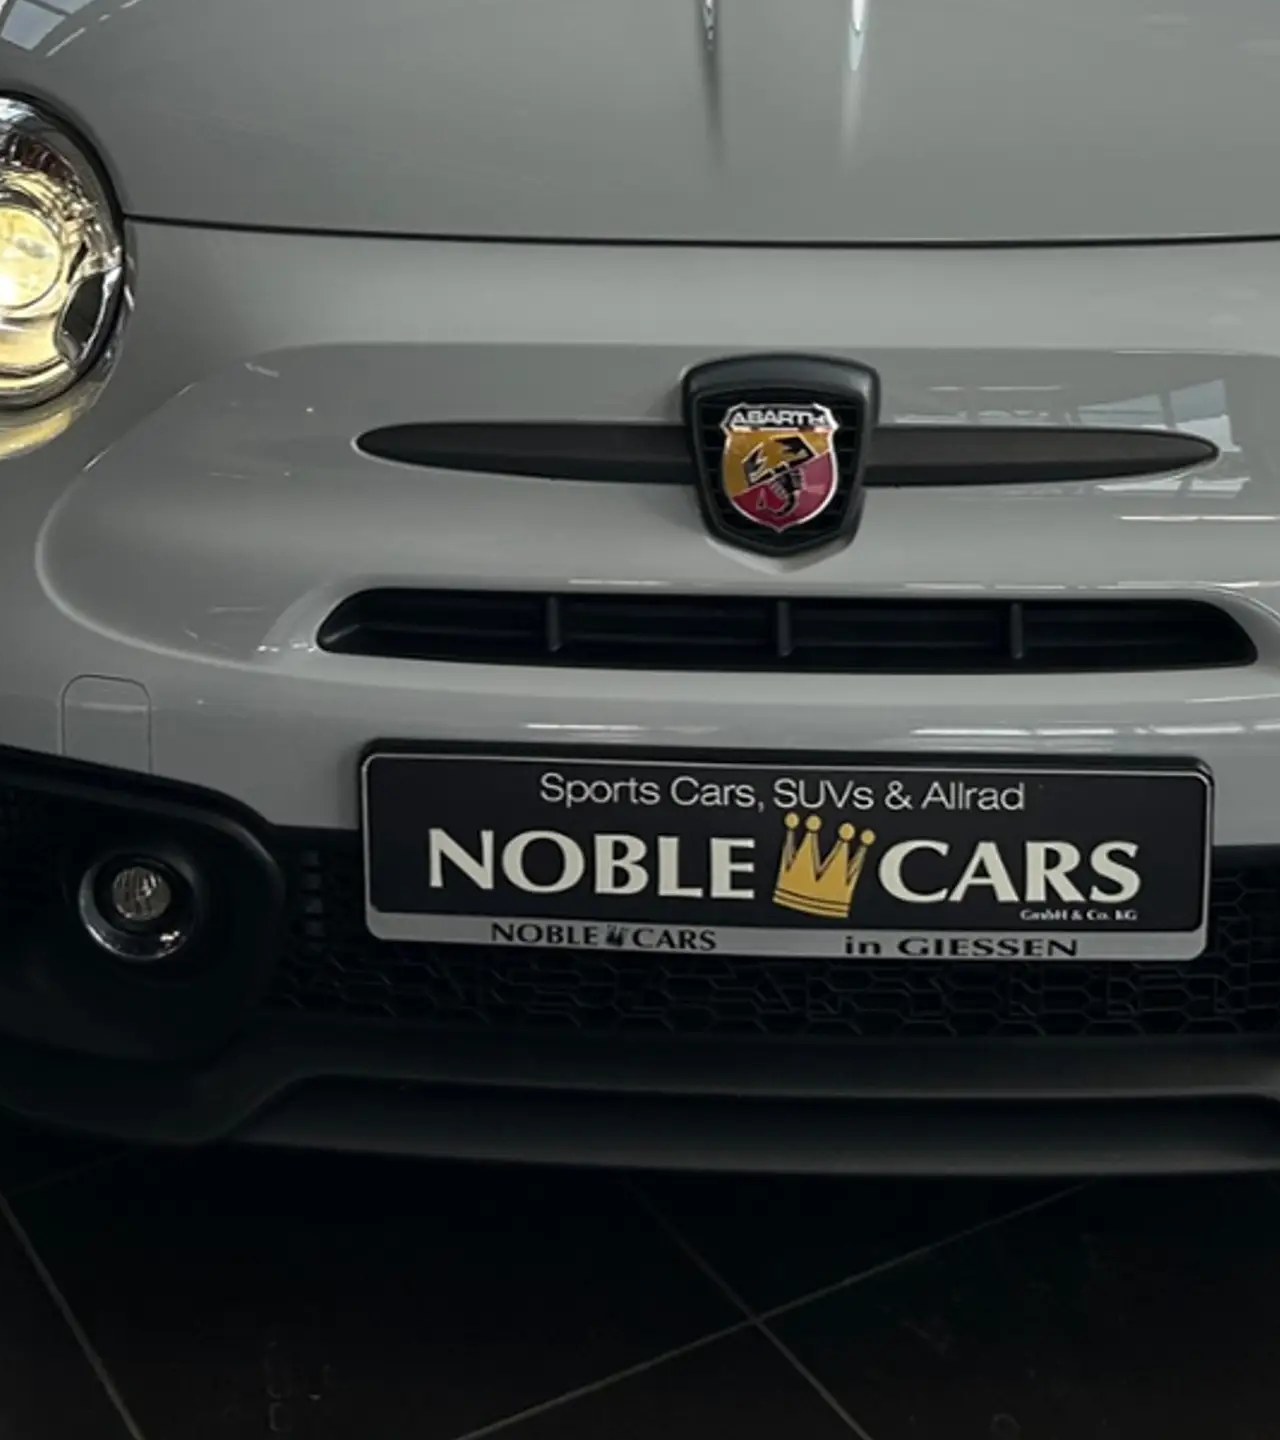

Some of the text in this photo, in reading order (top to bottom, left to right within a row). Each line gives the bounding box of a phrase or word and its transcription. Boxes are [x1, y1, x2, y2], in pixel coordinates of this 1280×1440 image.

[730, 409, 829, 427] ABARTH
[539, 772, 1026, 813] Sports Cars, SUVs & Allrad
[428, 827, 1142, 905] NOBLE CARS
[1019, 907, 1069, 921] GmbH
[1071, 909, 1083, 921] &
[490, 921, 718, 952] NOBLE CARS
[844, 935, 1078, 958] in GIESSEN
